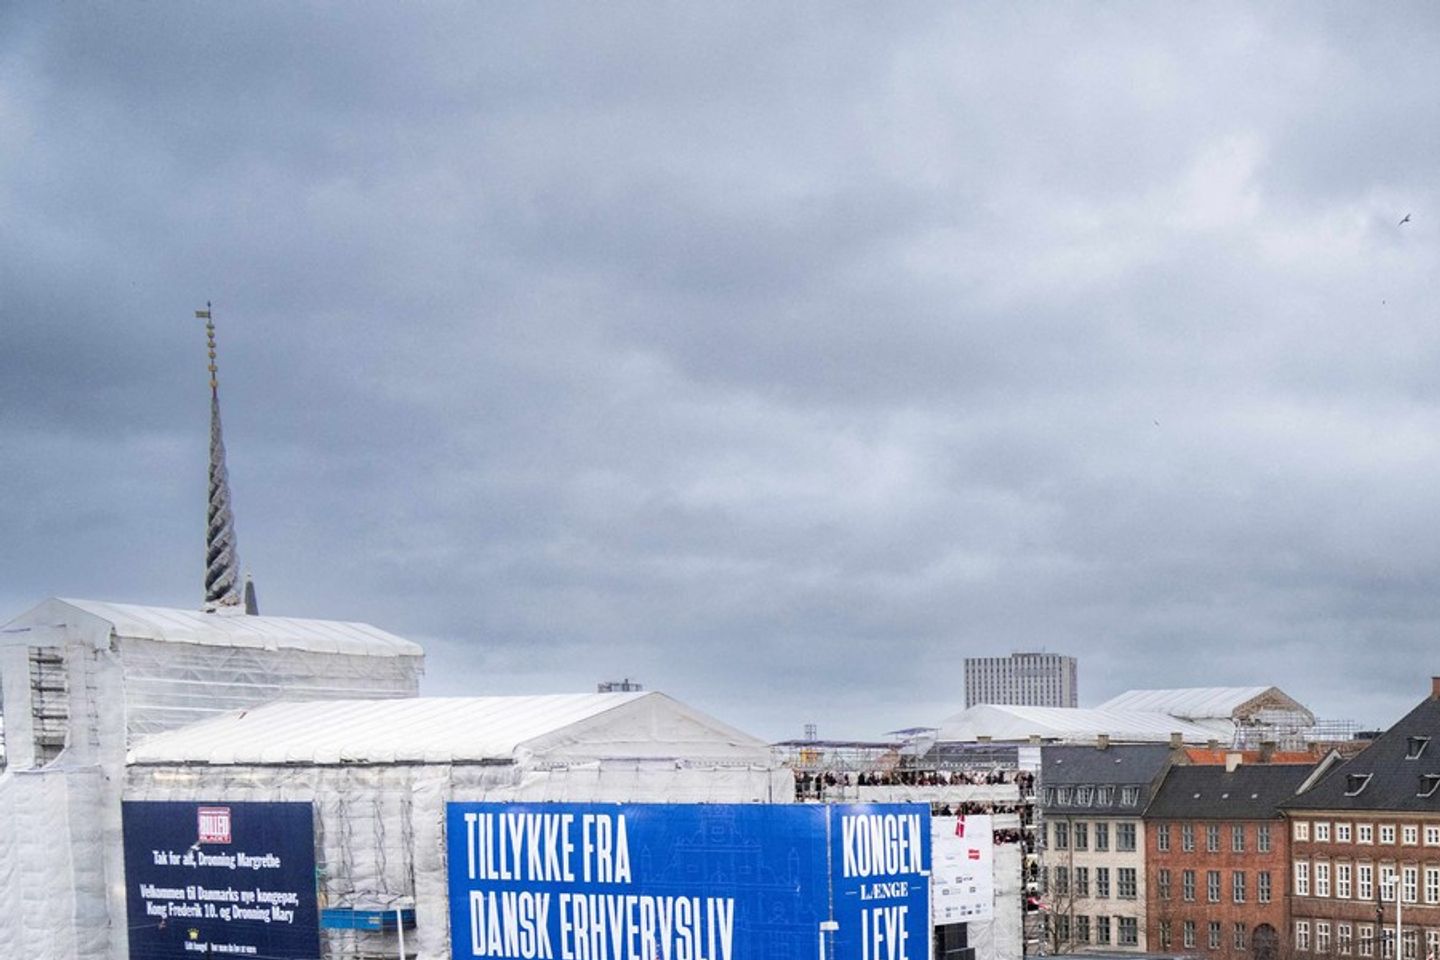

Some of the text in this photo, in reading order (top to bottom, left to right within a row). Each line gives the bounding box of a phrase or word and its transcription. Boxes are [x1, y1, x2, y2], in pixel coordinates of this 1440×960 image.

[464, 812, 632, 884] TILLYKKE FRA
[842, 813, 922, 878] KONGEN
[152, 850, 167, 865] Tak
[169, 850, 181, 865] for
[198, 851, 236, 869] Dronning
[237, 852, 281, 870] Margrethe
[140, 884, 299, 907] Velkommen til Danmarks nye kongepar,
[859, 881, 909, 901] LÆNGE
[146, 901, 294, 924] Kong Frederik 10. og Dronning Mary
[469, 890, 553, 960] DANSK
